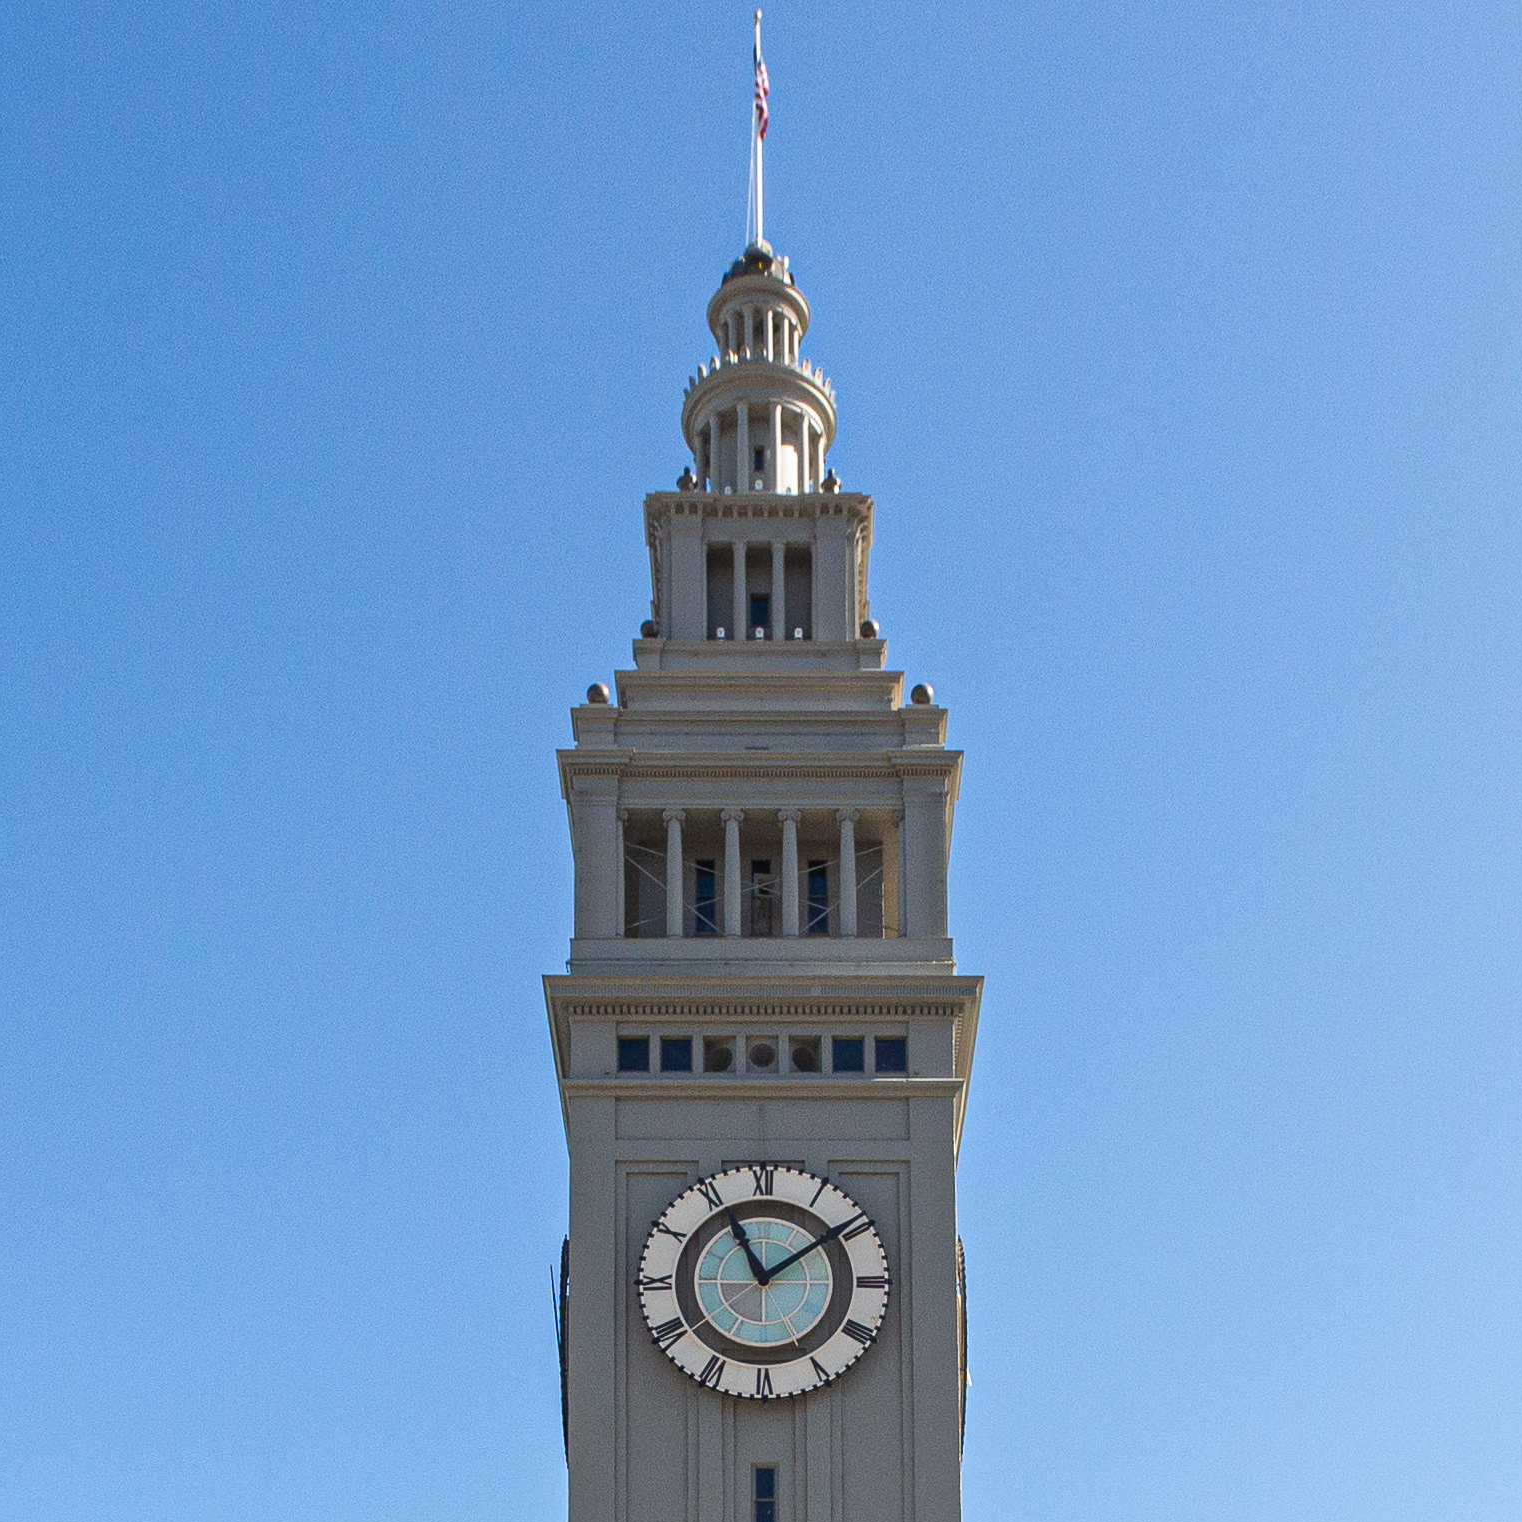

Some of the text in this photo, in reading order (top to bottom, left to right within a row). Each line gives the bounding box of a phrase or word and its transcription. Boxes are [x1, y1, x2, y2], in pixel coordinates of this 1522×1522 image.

[752, 1169, 774, 1196] XII
[697, 1181, 724, 1212] XI
[657, 1222, 687, 1244] X
[856, 1276, 885, 1289] III
